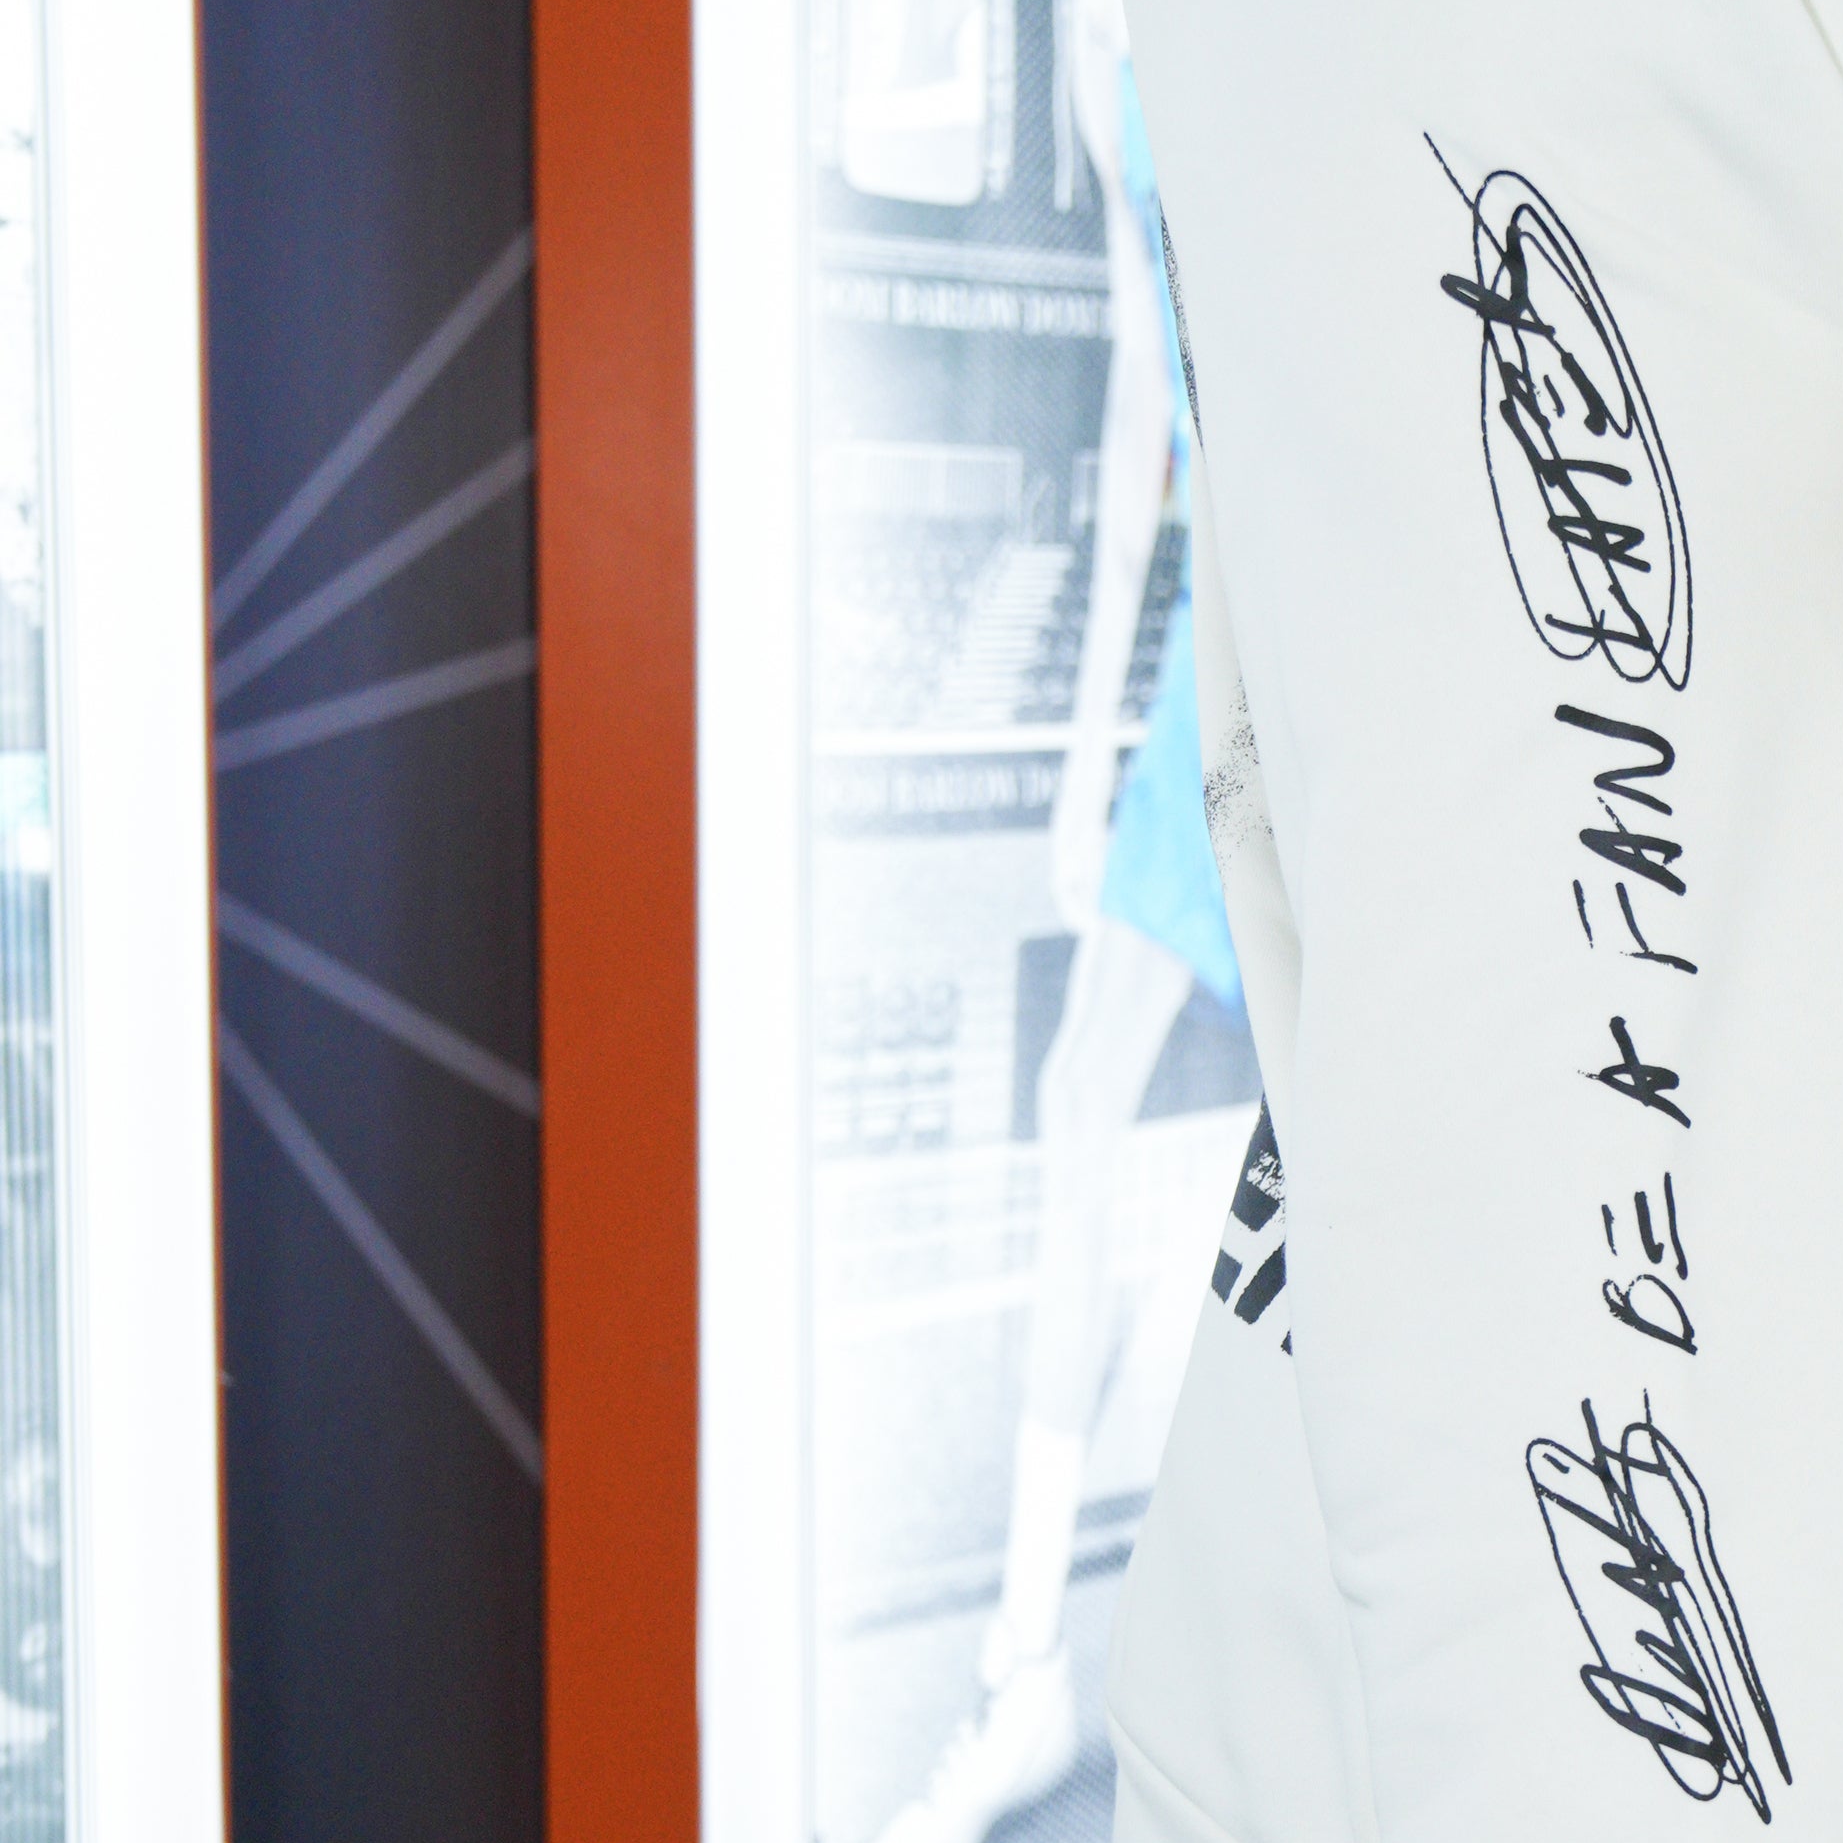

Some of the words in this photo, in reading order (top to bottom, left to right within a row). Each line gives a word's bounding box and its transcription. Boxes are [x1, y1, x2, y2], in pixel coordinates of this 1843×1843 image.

[1555, 704, 1698, 974] FAN
[1578, 1016, 1691, 1129] A
[1602, 1172, 1697, 1355] BE
